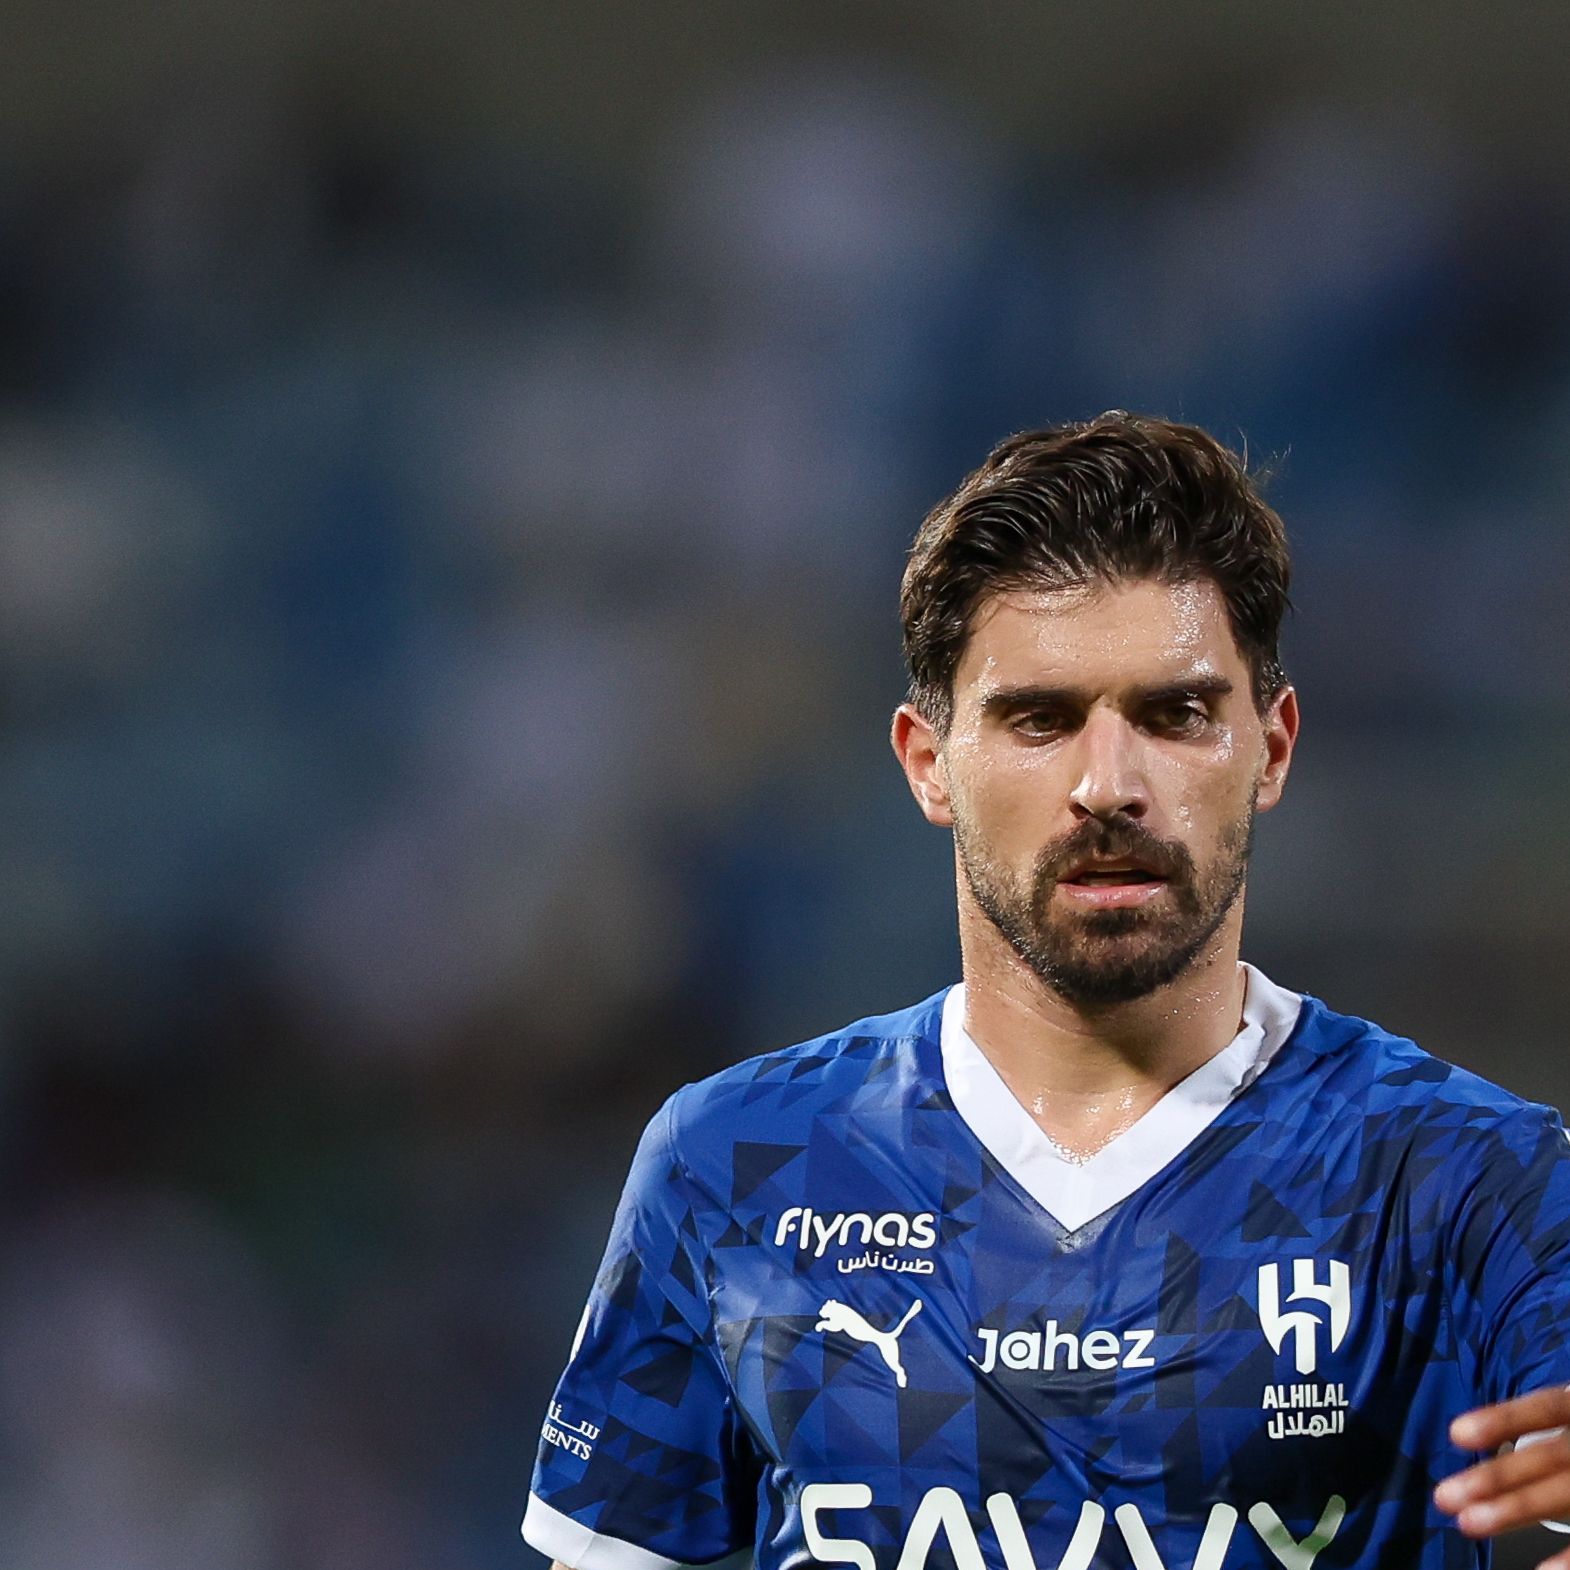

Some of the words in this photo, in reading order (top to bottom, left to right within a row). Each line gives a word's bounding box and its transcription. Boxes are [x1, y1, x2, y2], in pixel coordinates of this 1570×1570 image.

[774, 1207, 937, 1258] flynas
[1262, 1383, 1349, 1410] ALHILAL
[1267, 1410, 1345, 1440] الهلال
